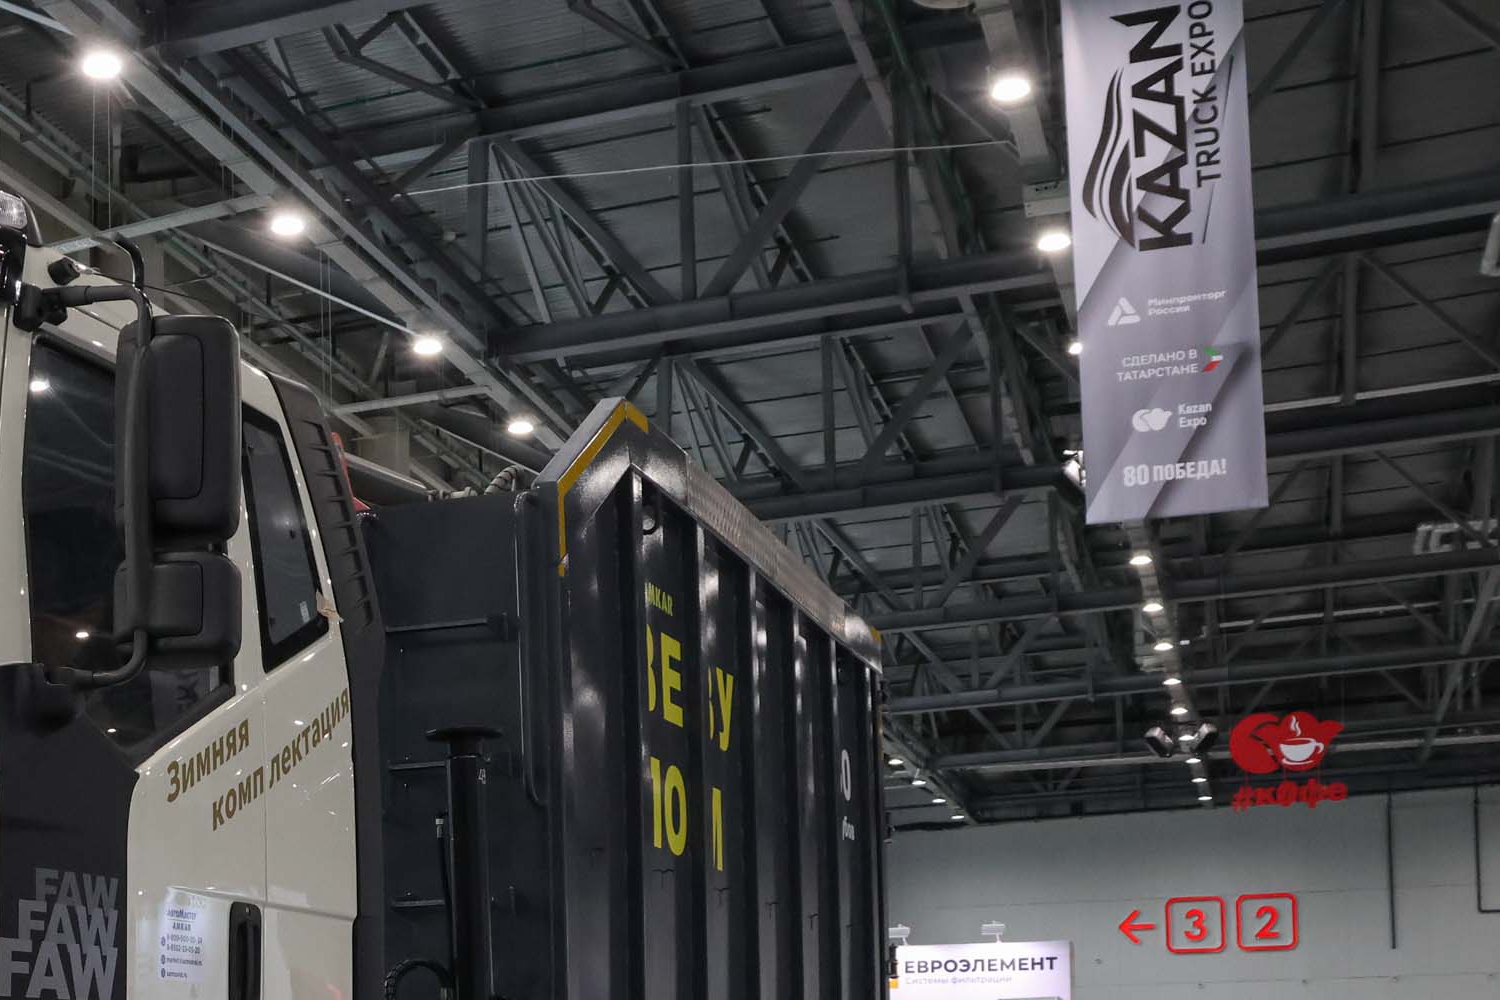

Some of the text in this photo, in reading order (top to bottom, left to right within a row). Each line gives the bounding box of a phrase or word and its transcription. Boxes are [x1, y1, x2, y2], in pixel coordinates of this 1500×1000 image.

[1186, 0, 1221, 188] TRUCK EXPO
[1109, 4, 1193, 252] KAZAN
[1115, 363, 1199, 382] ТАТАРСТАНЕ
[1121, 349, 1198, 368] СДЕЛАНО В
[1177, 402, 1213, 416] Kazan
[1179, 415, 1208, 429] Expo
[1123, 458, 1228, 487] 80 ПОБЕДА!
[166, 718, 250, 803] Зимняя
[35, 867, 119, 916] FAW
[18, 898, 118, 955] FAW
[1184, 905, 1280, 941] 3 2
[904, 957, 1058, 974] ЕВРОЭЛЕМЕНТ
